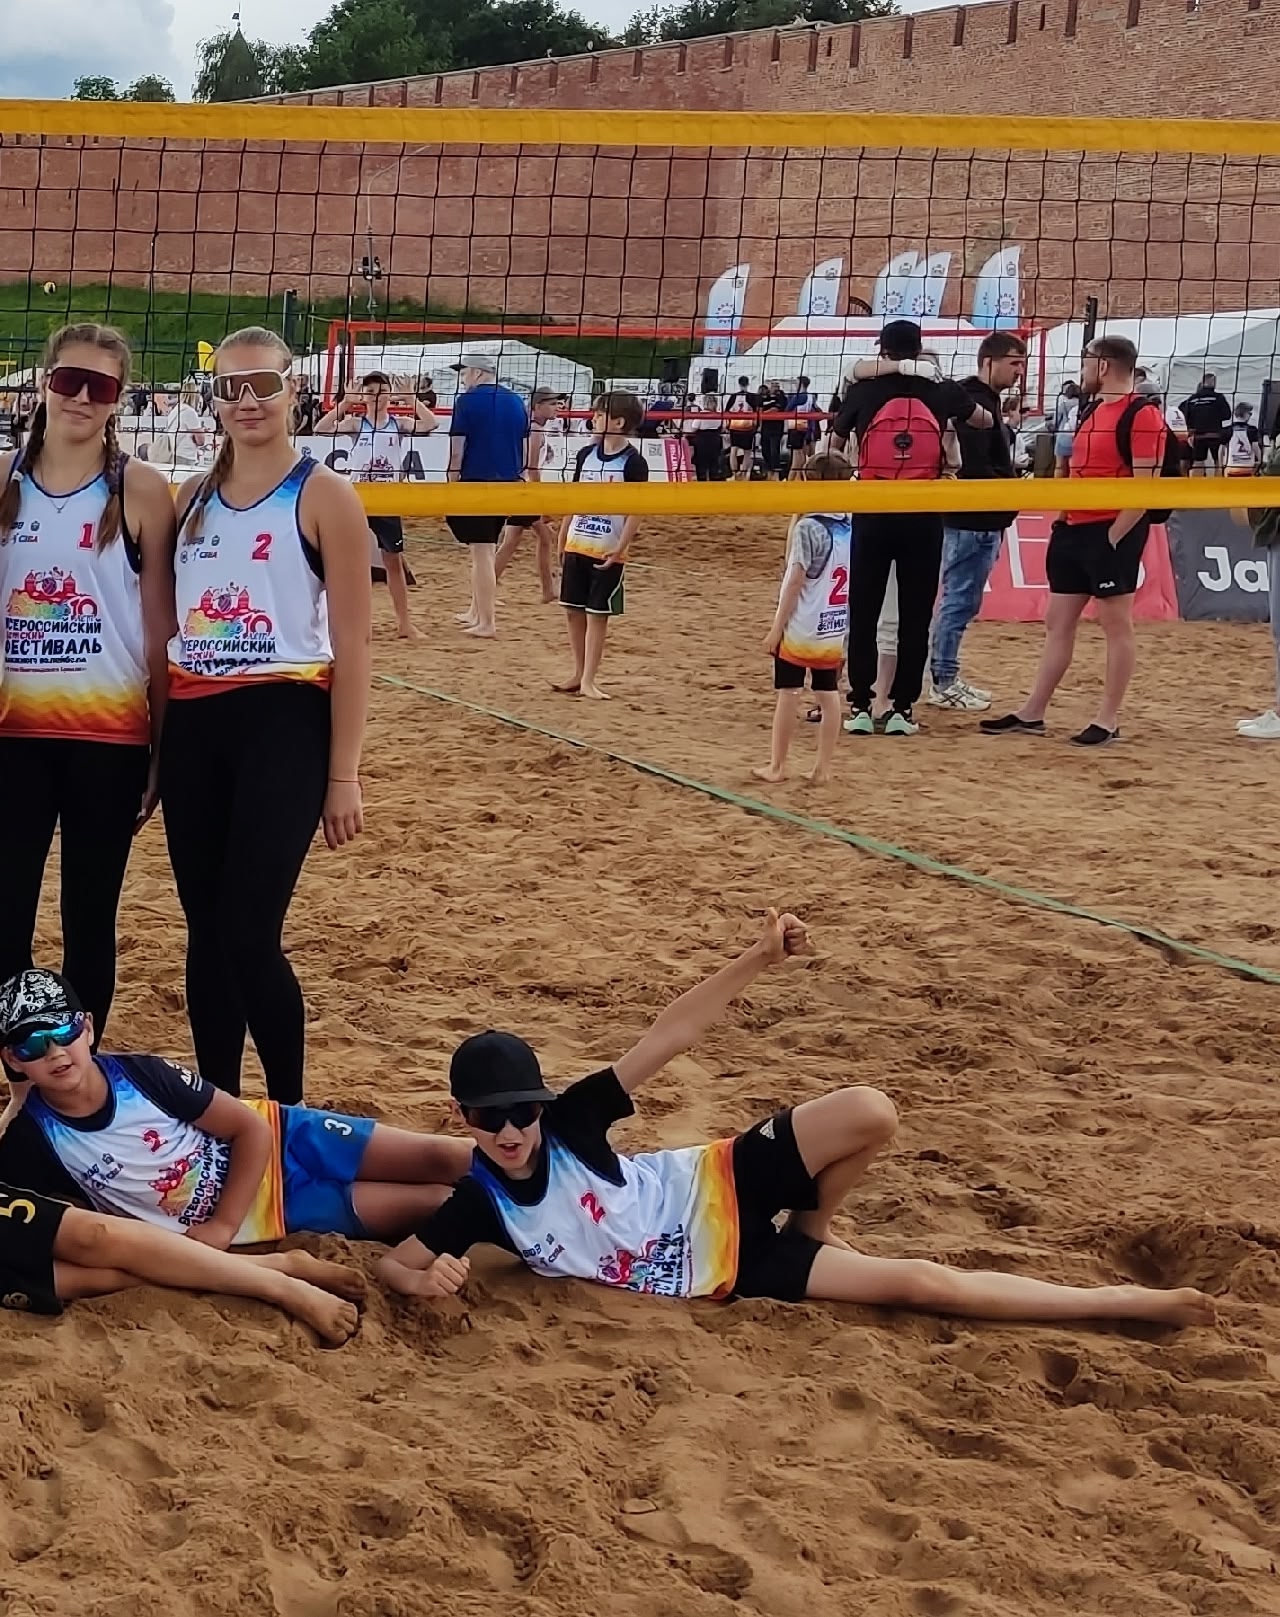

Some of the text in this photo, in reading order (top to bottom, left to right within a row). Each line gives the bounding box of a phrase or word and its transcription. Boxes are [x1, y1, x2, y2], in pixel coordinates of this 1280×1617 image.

[79, 523, 93, 548] 1
[252, 533, 272, 560] 2
[829, 567, 848, 605] 2
[70, 598, 98, 619] 10
[243, 614, 272, 639] 10
[323, 1118, 353, 1136] 3
[142, 1129, 162, 1152] 2
[579, 1192, 606, 1225] 2
